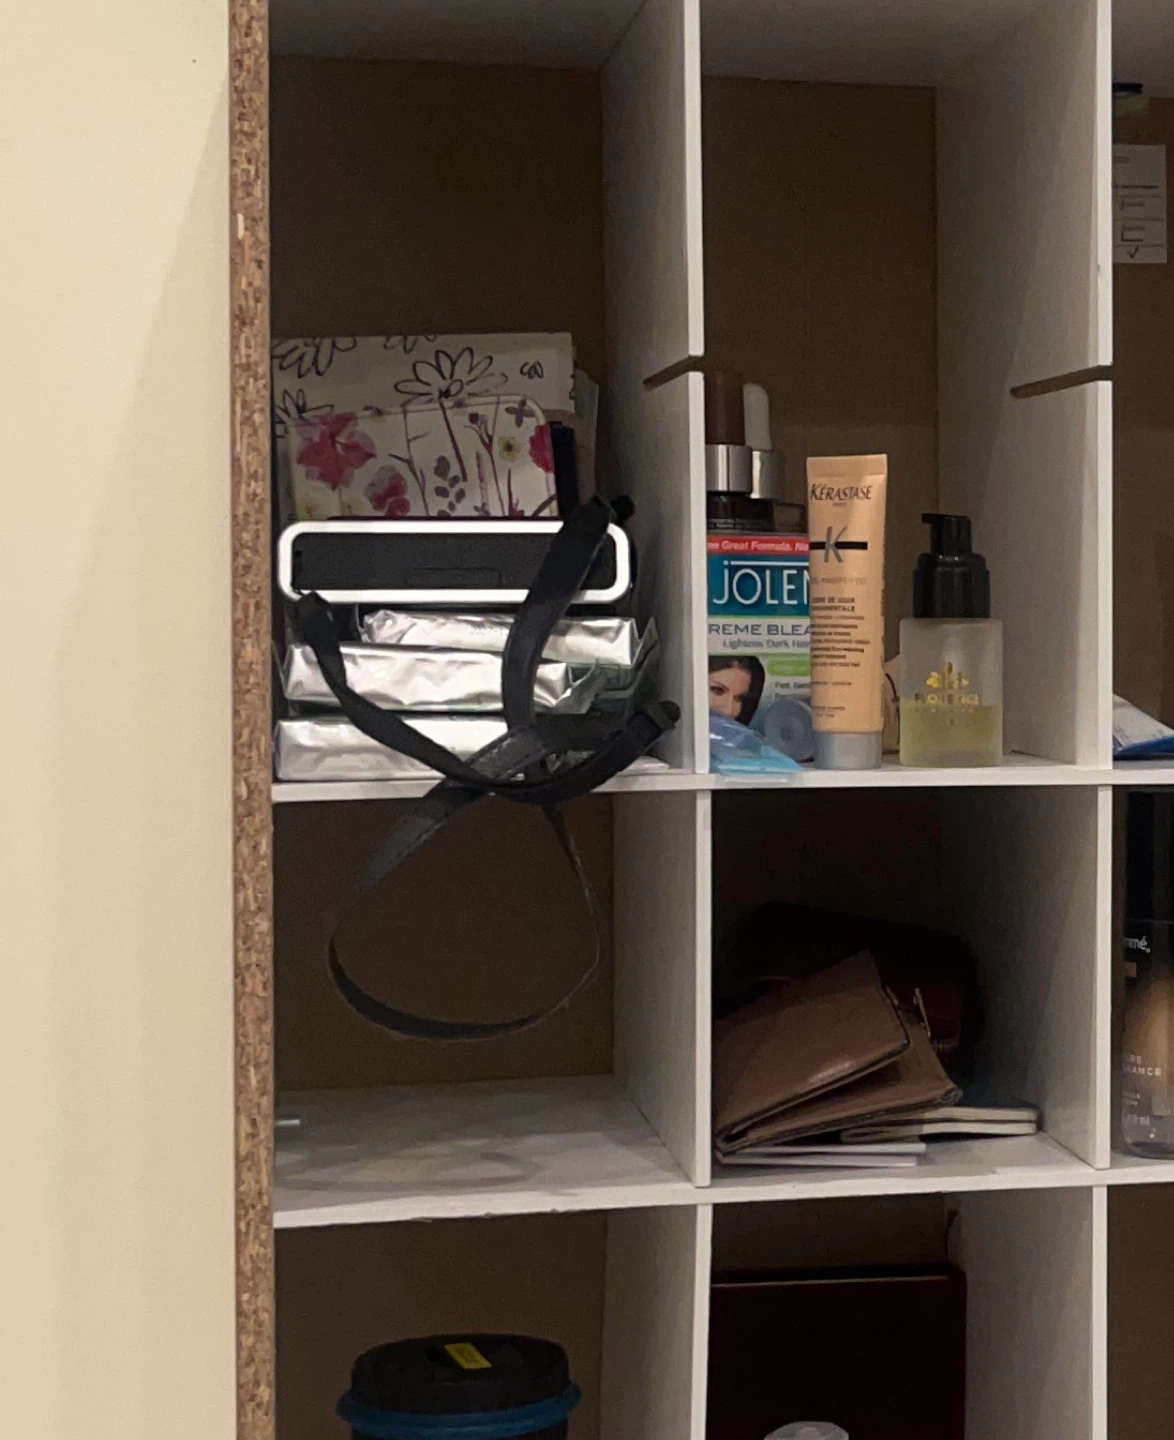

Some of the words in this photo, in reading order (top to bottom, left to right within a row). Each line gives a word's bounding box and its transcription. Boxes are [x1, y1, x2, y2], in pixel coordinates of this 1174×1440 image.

[811, 483, 873, 501] KÉRASTASE
[708, 623, 763, 636] REME
[767, 623, 811, 636] BLEA
